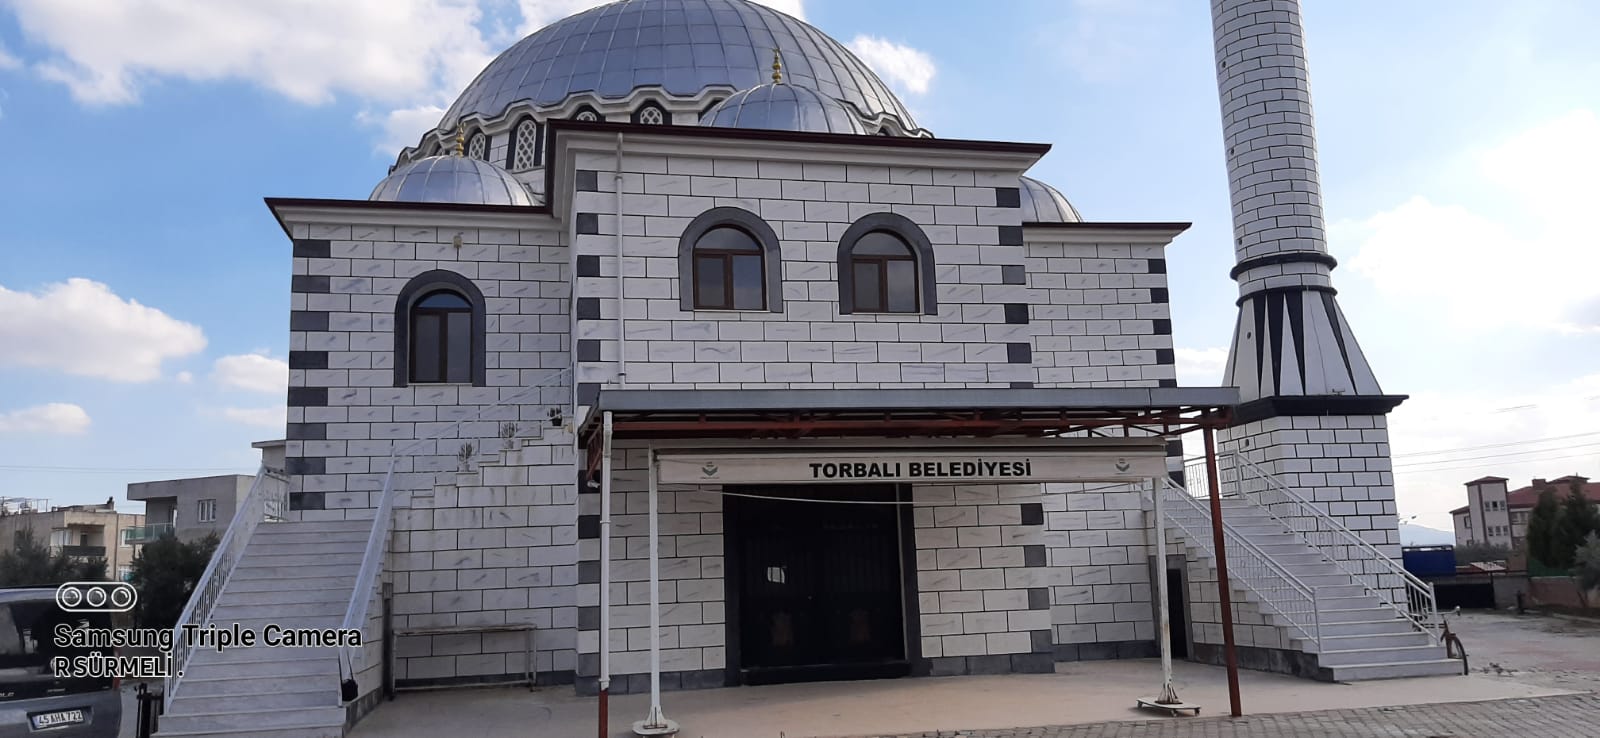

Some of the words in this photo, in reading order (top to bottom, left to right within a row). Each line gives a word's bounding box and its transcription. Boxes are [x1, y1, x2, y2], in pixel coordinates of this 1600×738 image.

[809, 462, 900, 478] TORBALI
[909, 458, 1032, 477] BELEDİYESİ
[39, 714, 49, 724] 45
[67, 710, 82, 721] 722
